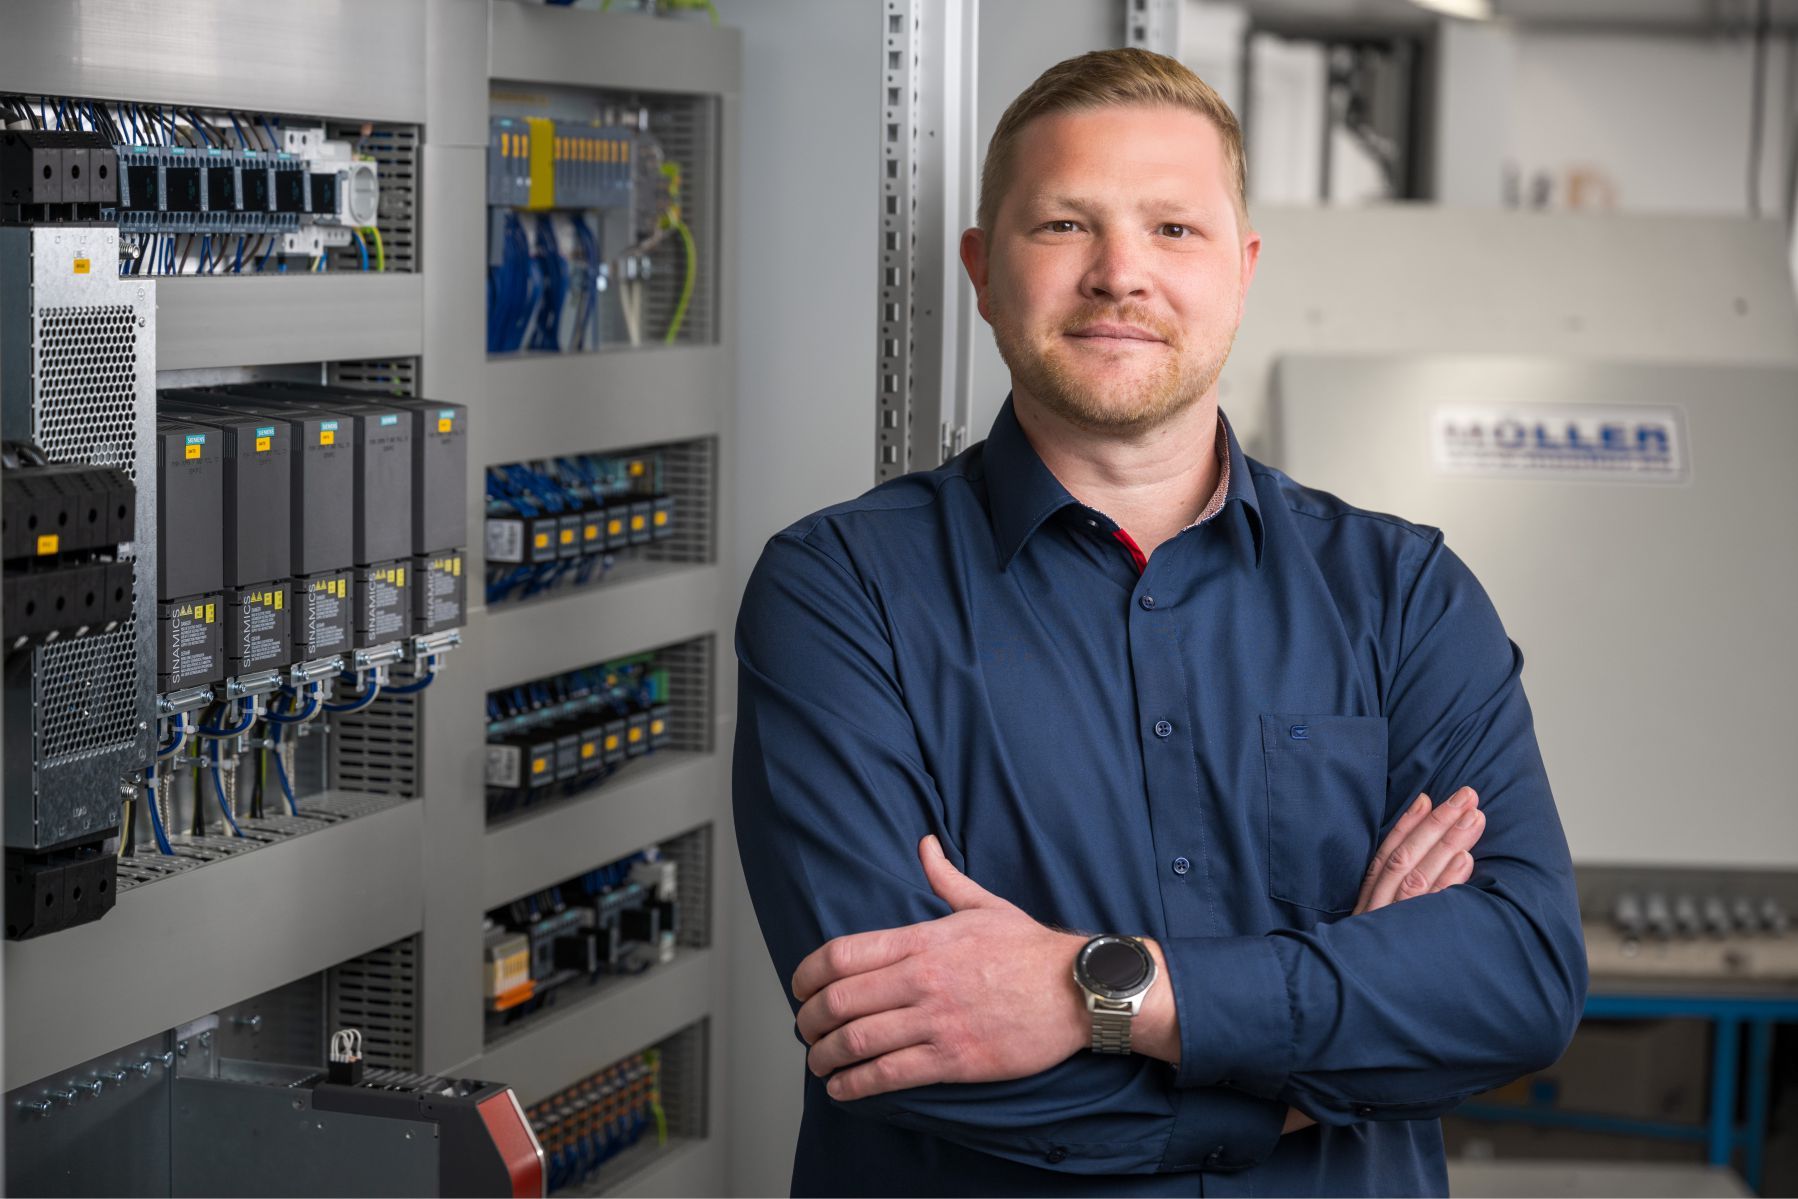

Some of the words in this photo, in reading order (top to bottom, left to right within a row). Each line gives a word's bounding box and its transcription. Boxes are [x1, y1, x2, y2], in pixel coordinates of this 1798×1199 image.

[172, 608, 181, 684] SINAMICS
[243, 595, 251, 667] SINAMICS
[308, 584, 316, 654] SINAMICS
